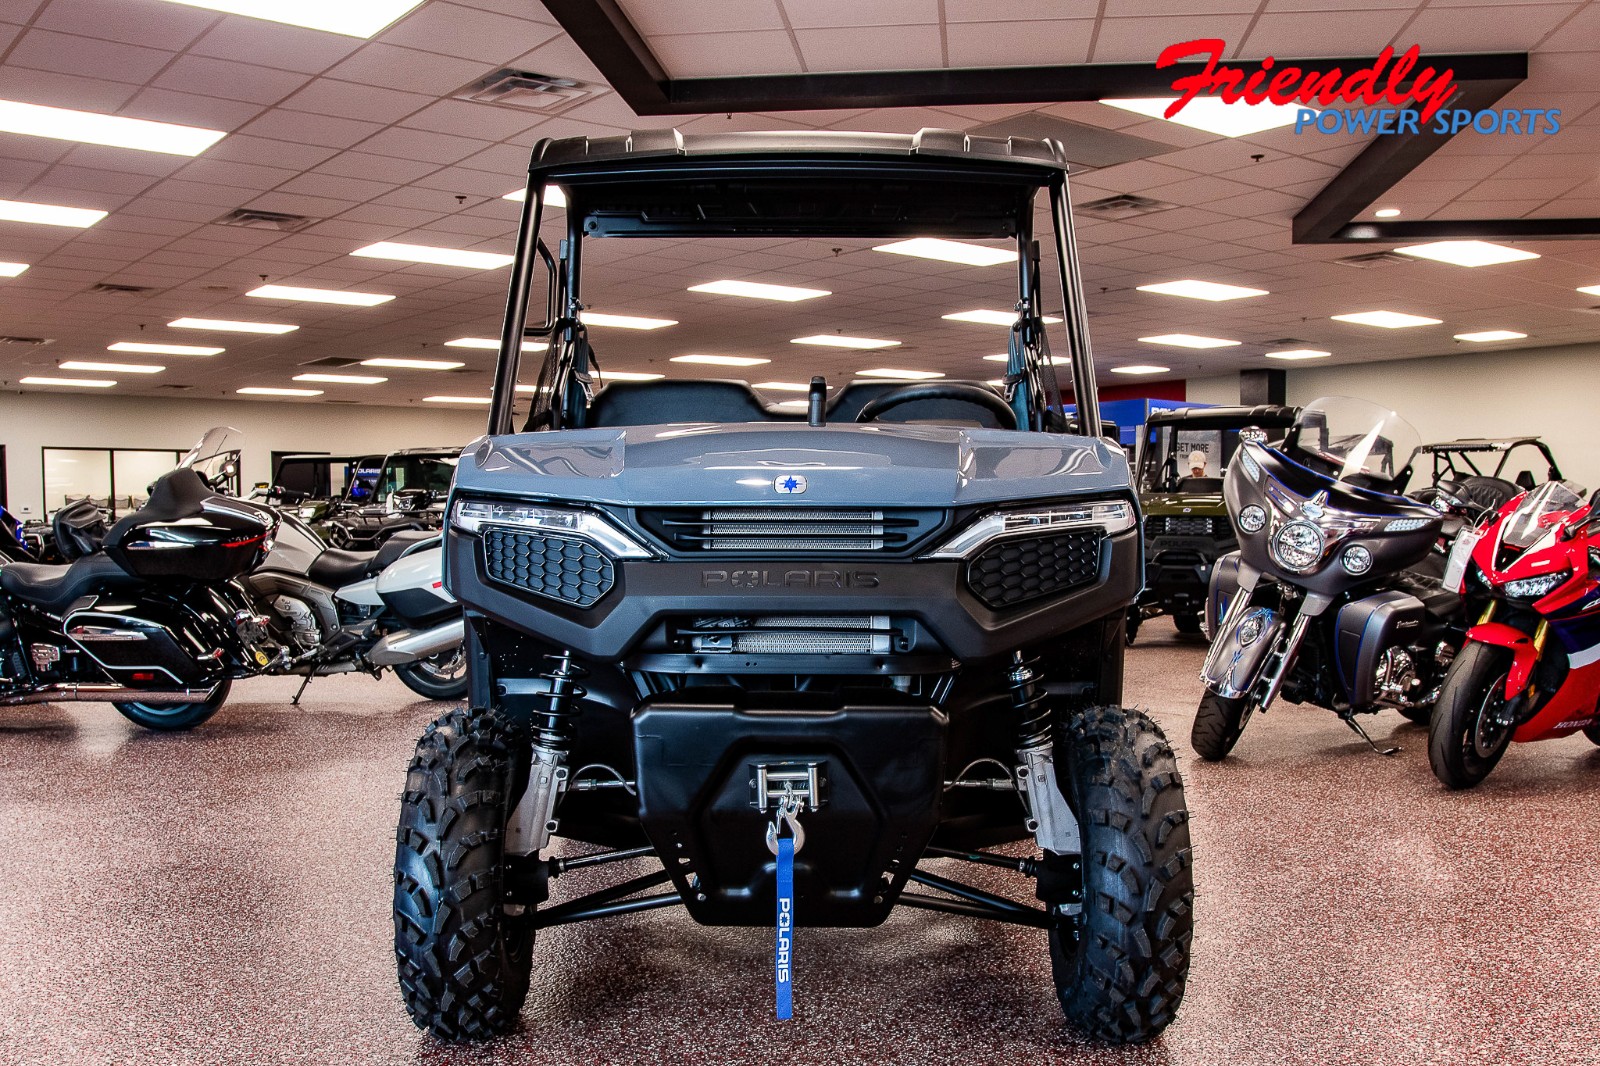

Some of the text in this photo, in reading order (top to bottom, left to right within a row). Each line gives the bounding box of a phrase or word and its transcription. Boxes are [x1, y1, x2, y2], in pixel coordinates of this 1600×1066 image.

[1191, 442, 1209, 453] MORE
[702, 570, 880, 588] POLARIS
[778, 898, 791, 983] POLARIS
